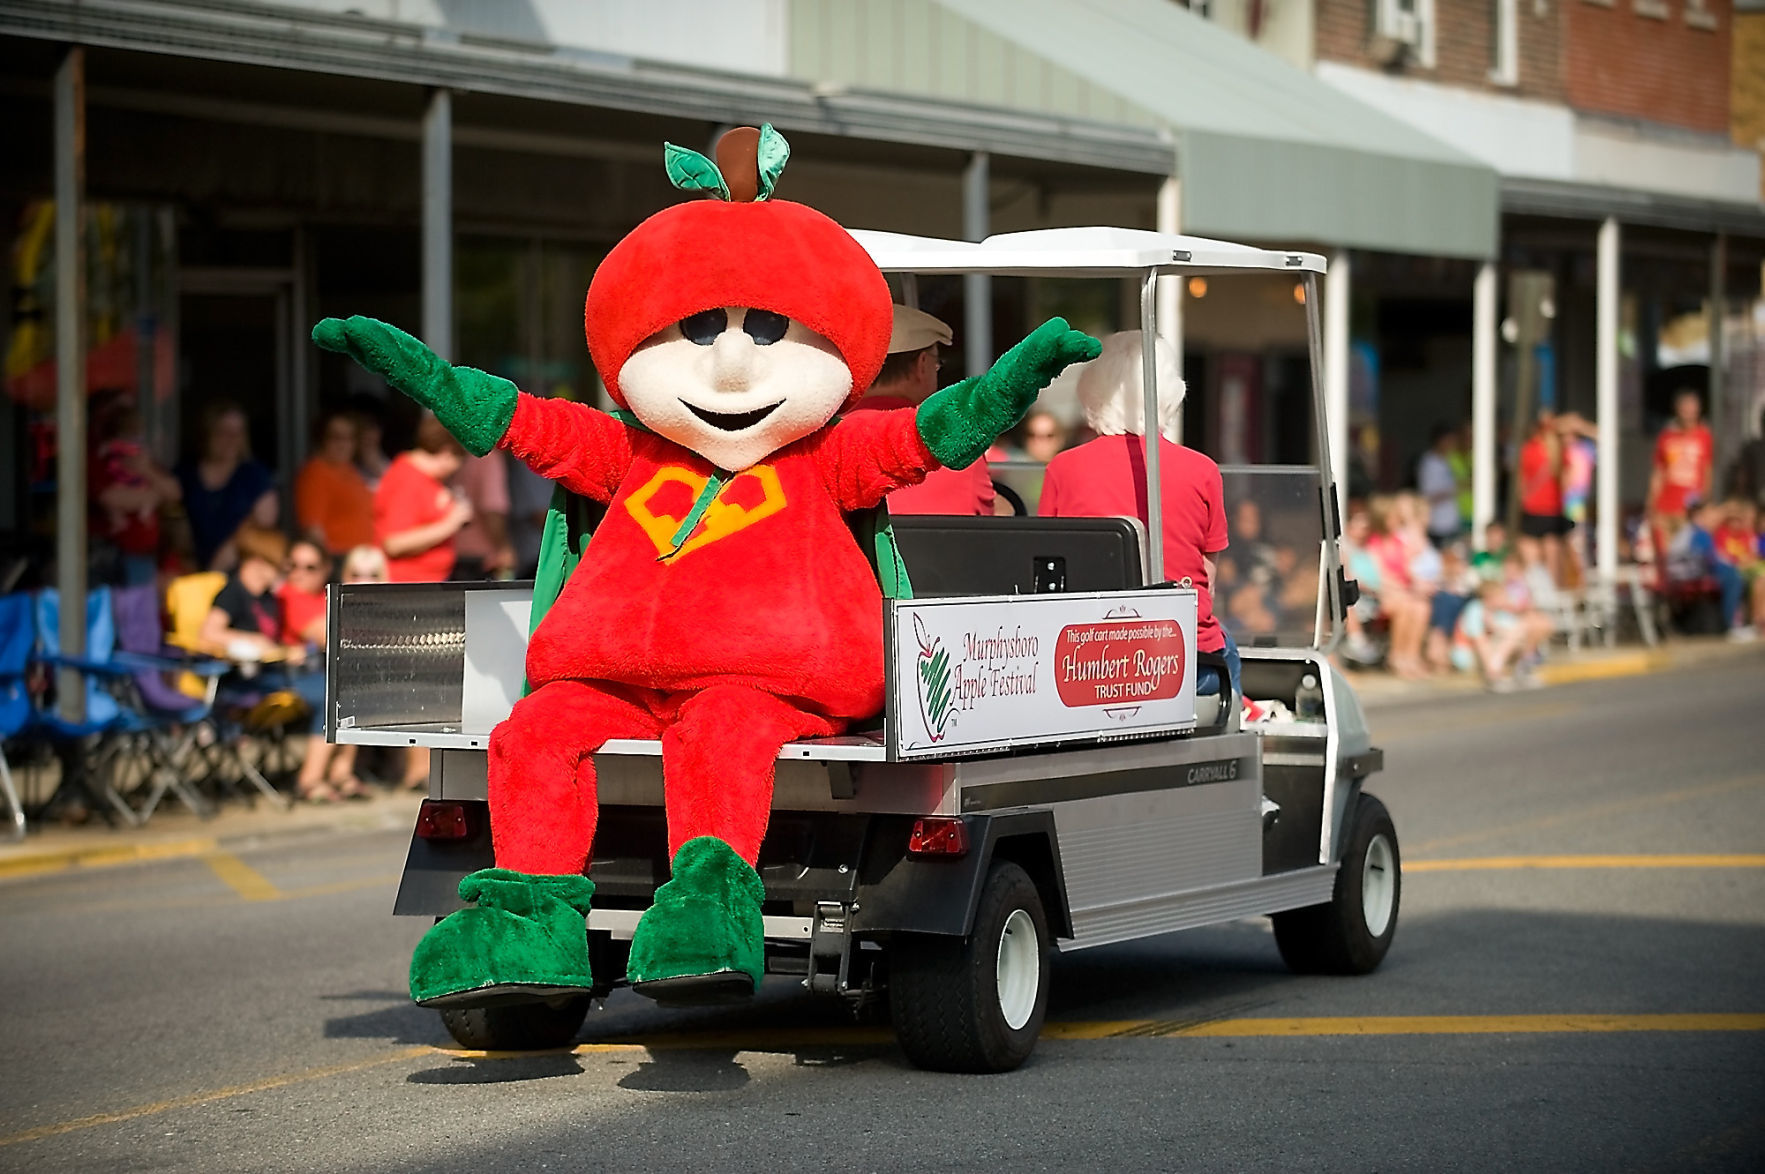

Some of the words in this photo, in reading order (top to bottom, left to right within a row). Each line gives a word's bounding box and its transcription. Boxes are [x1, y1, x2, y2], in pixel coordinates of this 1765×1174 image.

[963, 625, 1039, 671] Murphysboro
[1066, 629, 1080, 643] This
[1080, 627, 1095, 646] golf
[1095, 629, 1109, 642] cart
[1109, 627, 1128, 641] made
[1128, 625, 1154, 643] possible
[1154, 625, 1162, 641] by
[1062, 644, 1129, 682] Humbert
[1133, 649, 1179, 691] Rogers
[949, 664, 987, 711] Apple
[991, 661, 1039, 697] Festival
[1094, 683, 1124, 699] TRUST
[1125, 681, 1151, 697] FUND
[1187, 764, 1228, 784] CARRYALL
[1229, 760, 1237, 779] 6
